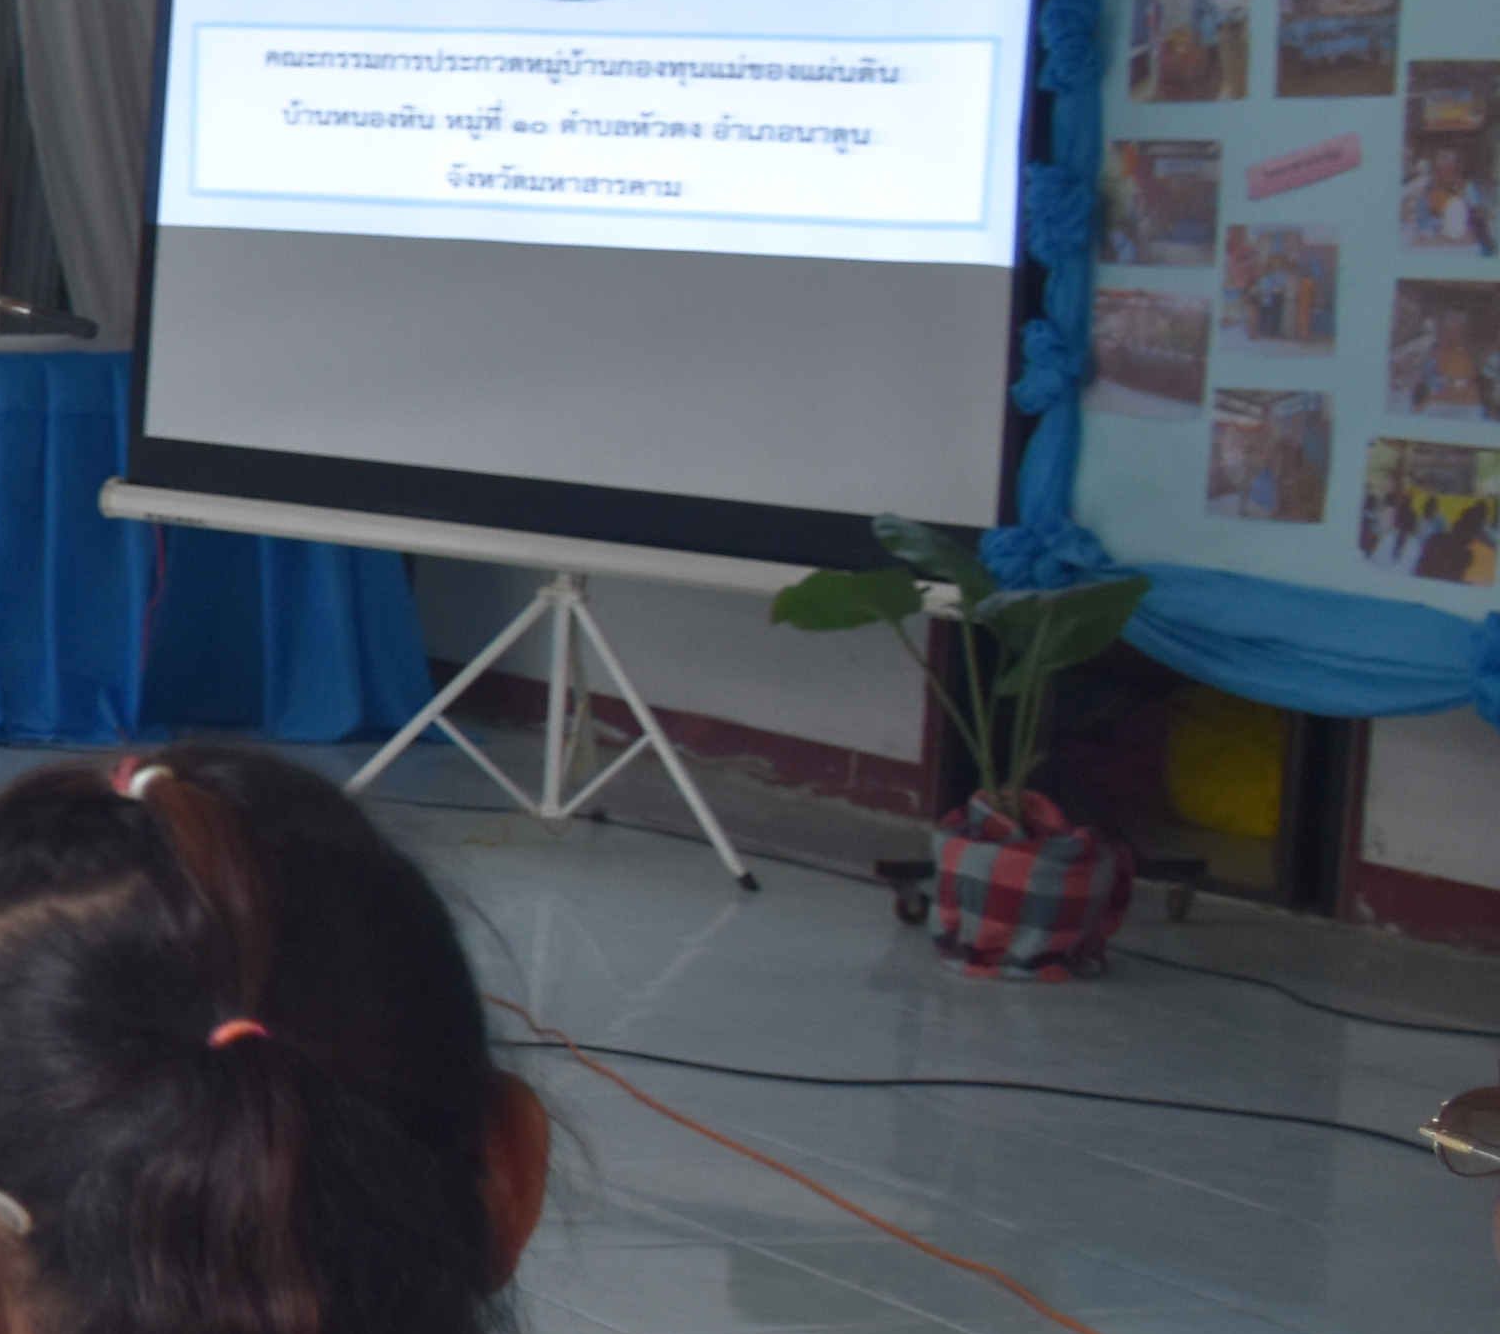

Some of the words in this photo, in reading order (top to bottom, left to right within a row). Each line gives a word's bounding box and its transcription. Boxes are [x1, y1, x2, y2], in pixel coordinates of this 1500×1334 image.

[263, 47, 900, 87] คณะกรรมการประกวดหมู่บ้านกองทุนแม่ของแผ่นดิน
[282, 98, 436, 132] บ้านหนองหิน
[444, 98, 503, 142] หมู่ที่
[559, 109, 703, 143] ตำบลหัวดง
[712, 113, 873, 155] อำเภอนาดูน
[446, 162, 683, 199] จังหวัดมหาสารคาม
